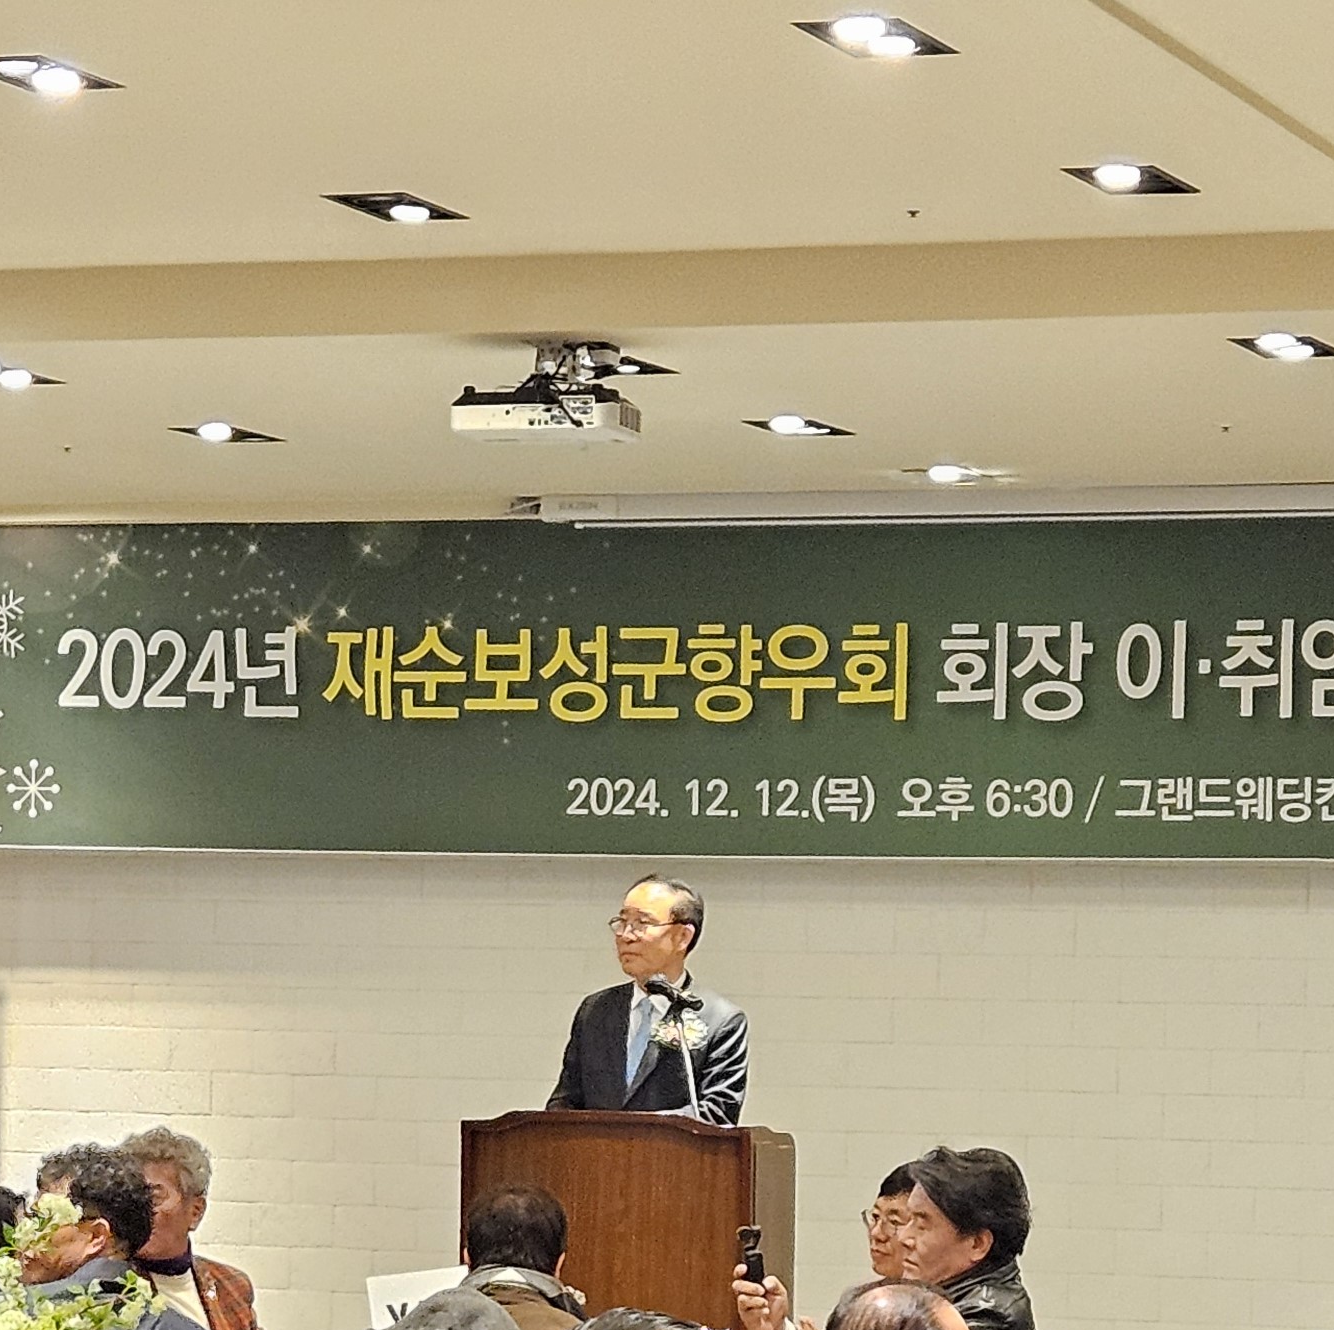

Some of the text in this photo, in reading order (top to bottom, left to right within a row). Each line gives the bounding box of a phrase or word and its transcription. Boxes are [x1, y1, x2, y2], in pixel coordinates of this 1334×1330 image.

[57, 624, 299, 718] 2024년
[321, 621, 909, 723] 재순보성군향우회
[936, 621, 1094, 722] 회장
[565, 777, 670, 818] 2024.
[685, 777, 740, 818] 12.
[755, 775, 877, 823] 12.(목)
[897, 776, 975, 822] 오후
[985, 777, 1075, 819] 6:30
